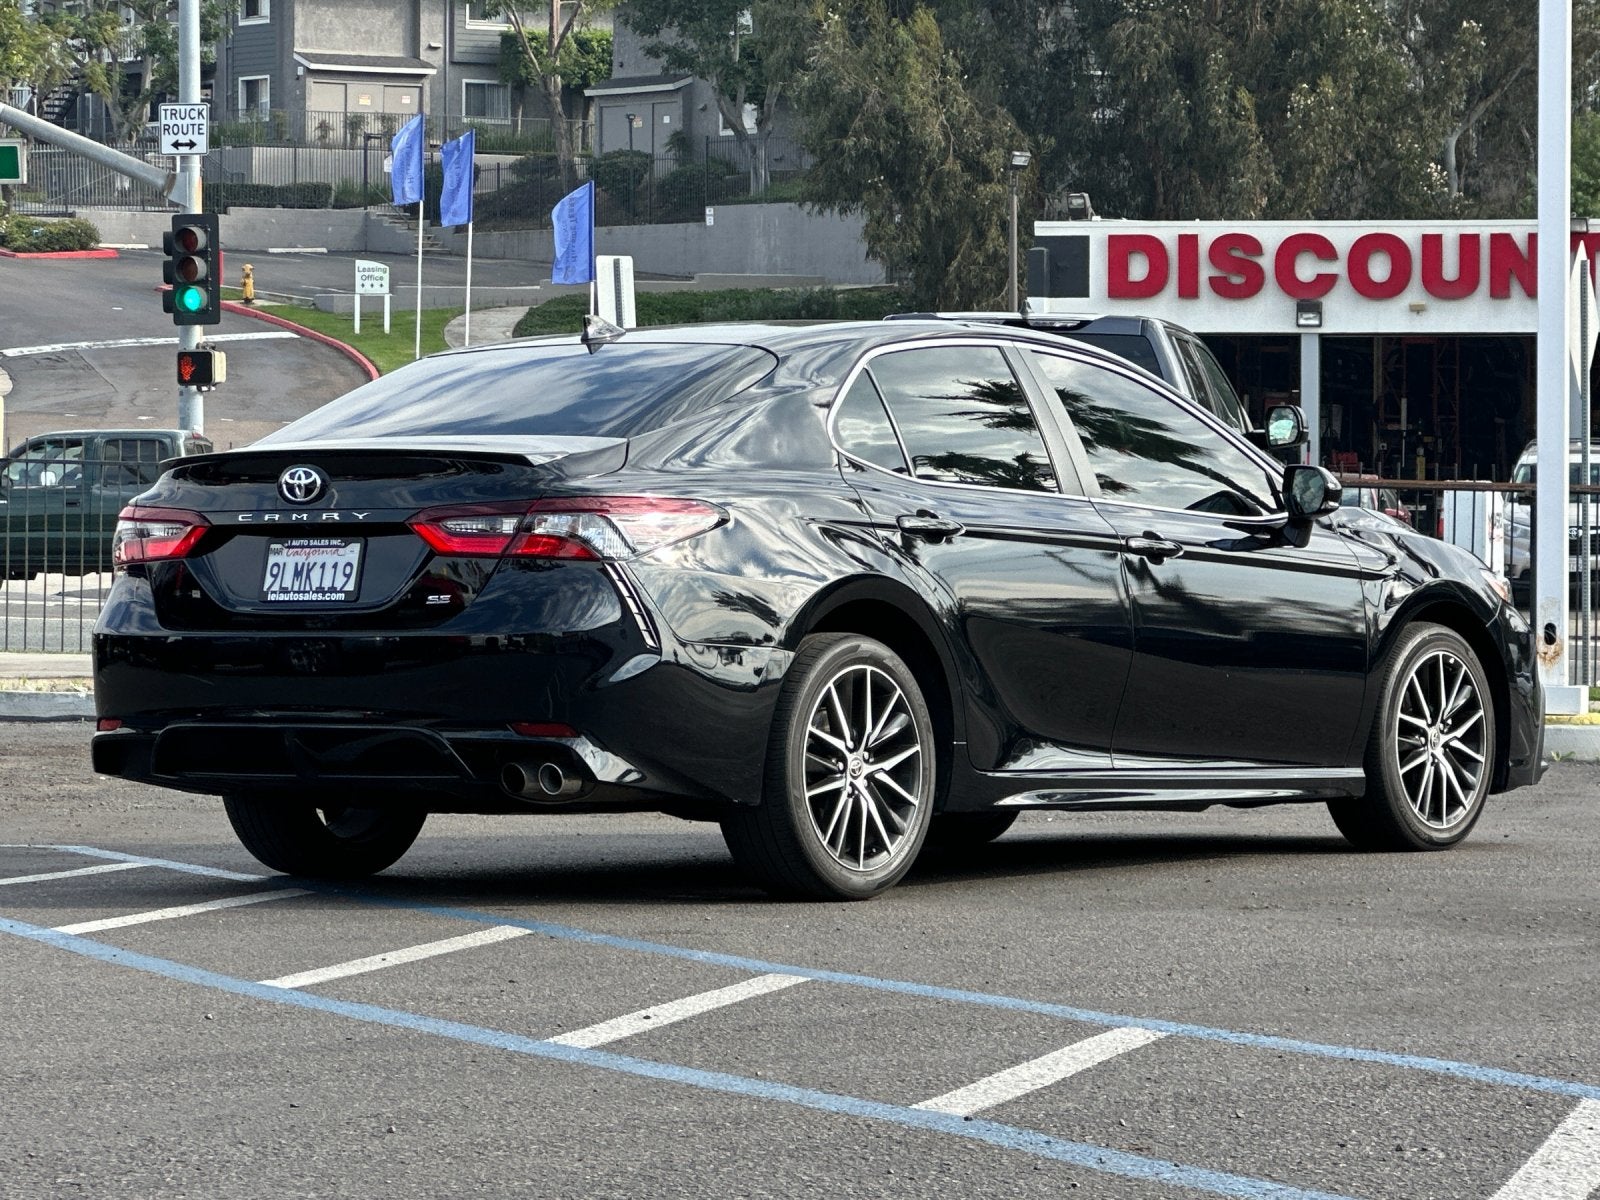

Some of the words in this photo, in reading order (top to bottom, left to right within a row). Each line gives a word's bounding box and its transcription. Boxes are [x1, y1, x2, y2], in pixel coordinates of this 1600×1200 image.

[162, 108, 206, 120] TRUCK
[163, 123, 205, 136] ROUTE
[357, 266, 388, 275] Leasing
[361, 274, 384, 282] Office
[238, 512, 371, 521] CAMRY
[286, 548, 344, 560] California
[266, 562, 354, 591] 9LMK119
